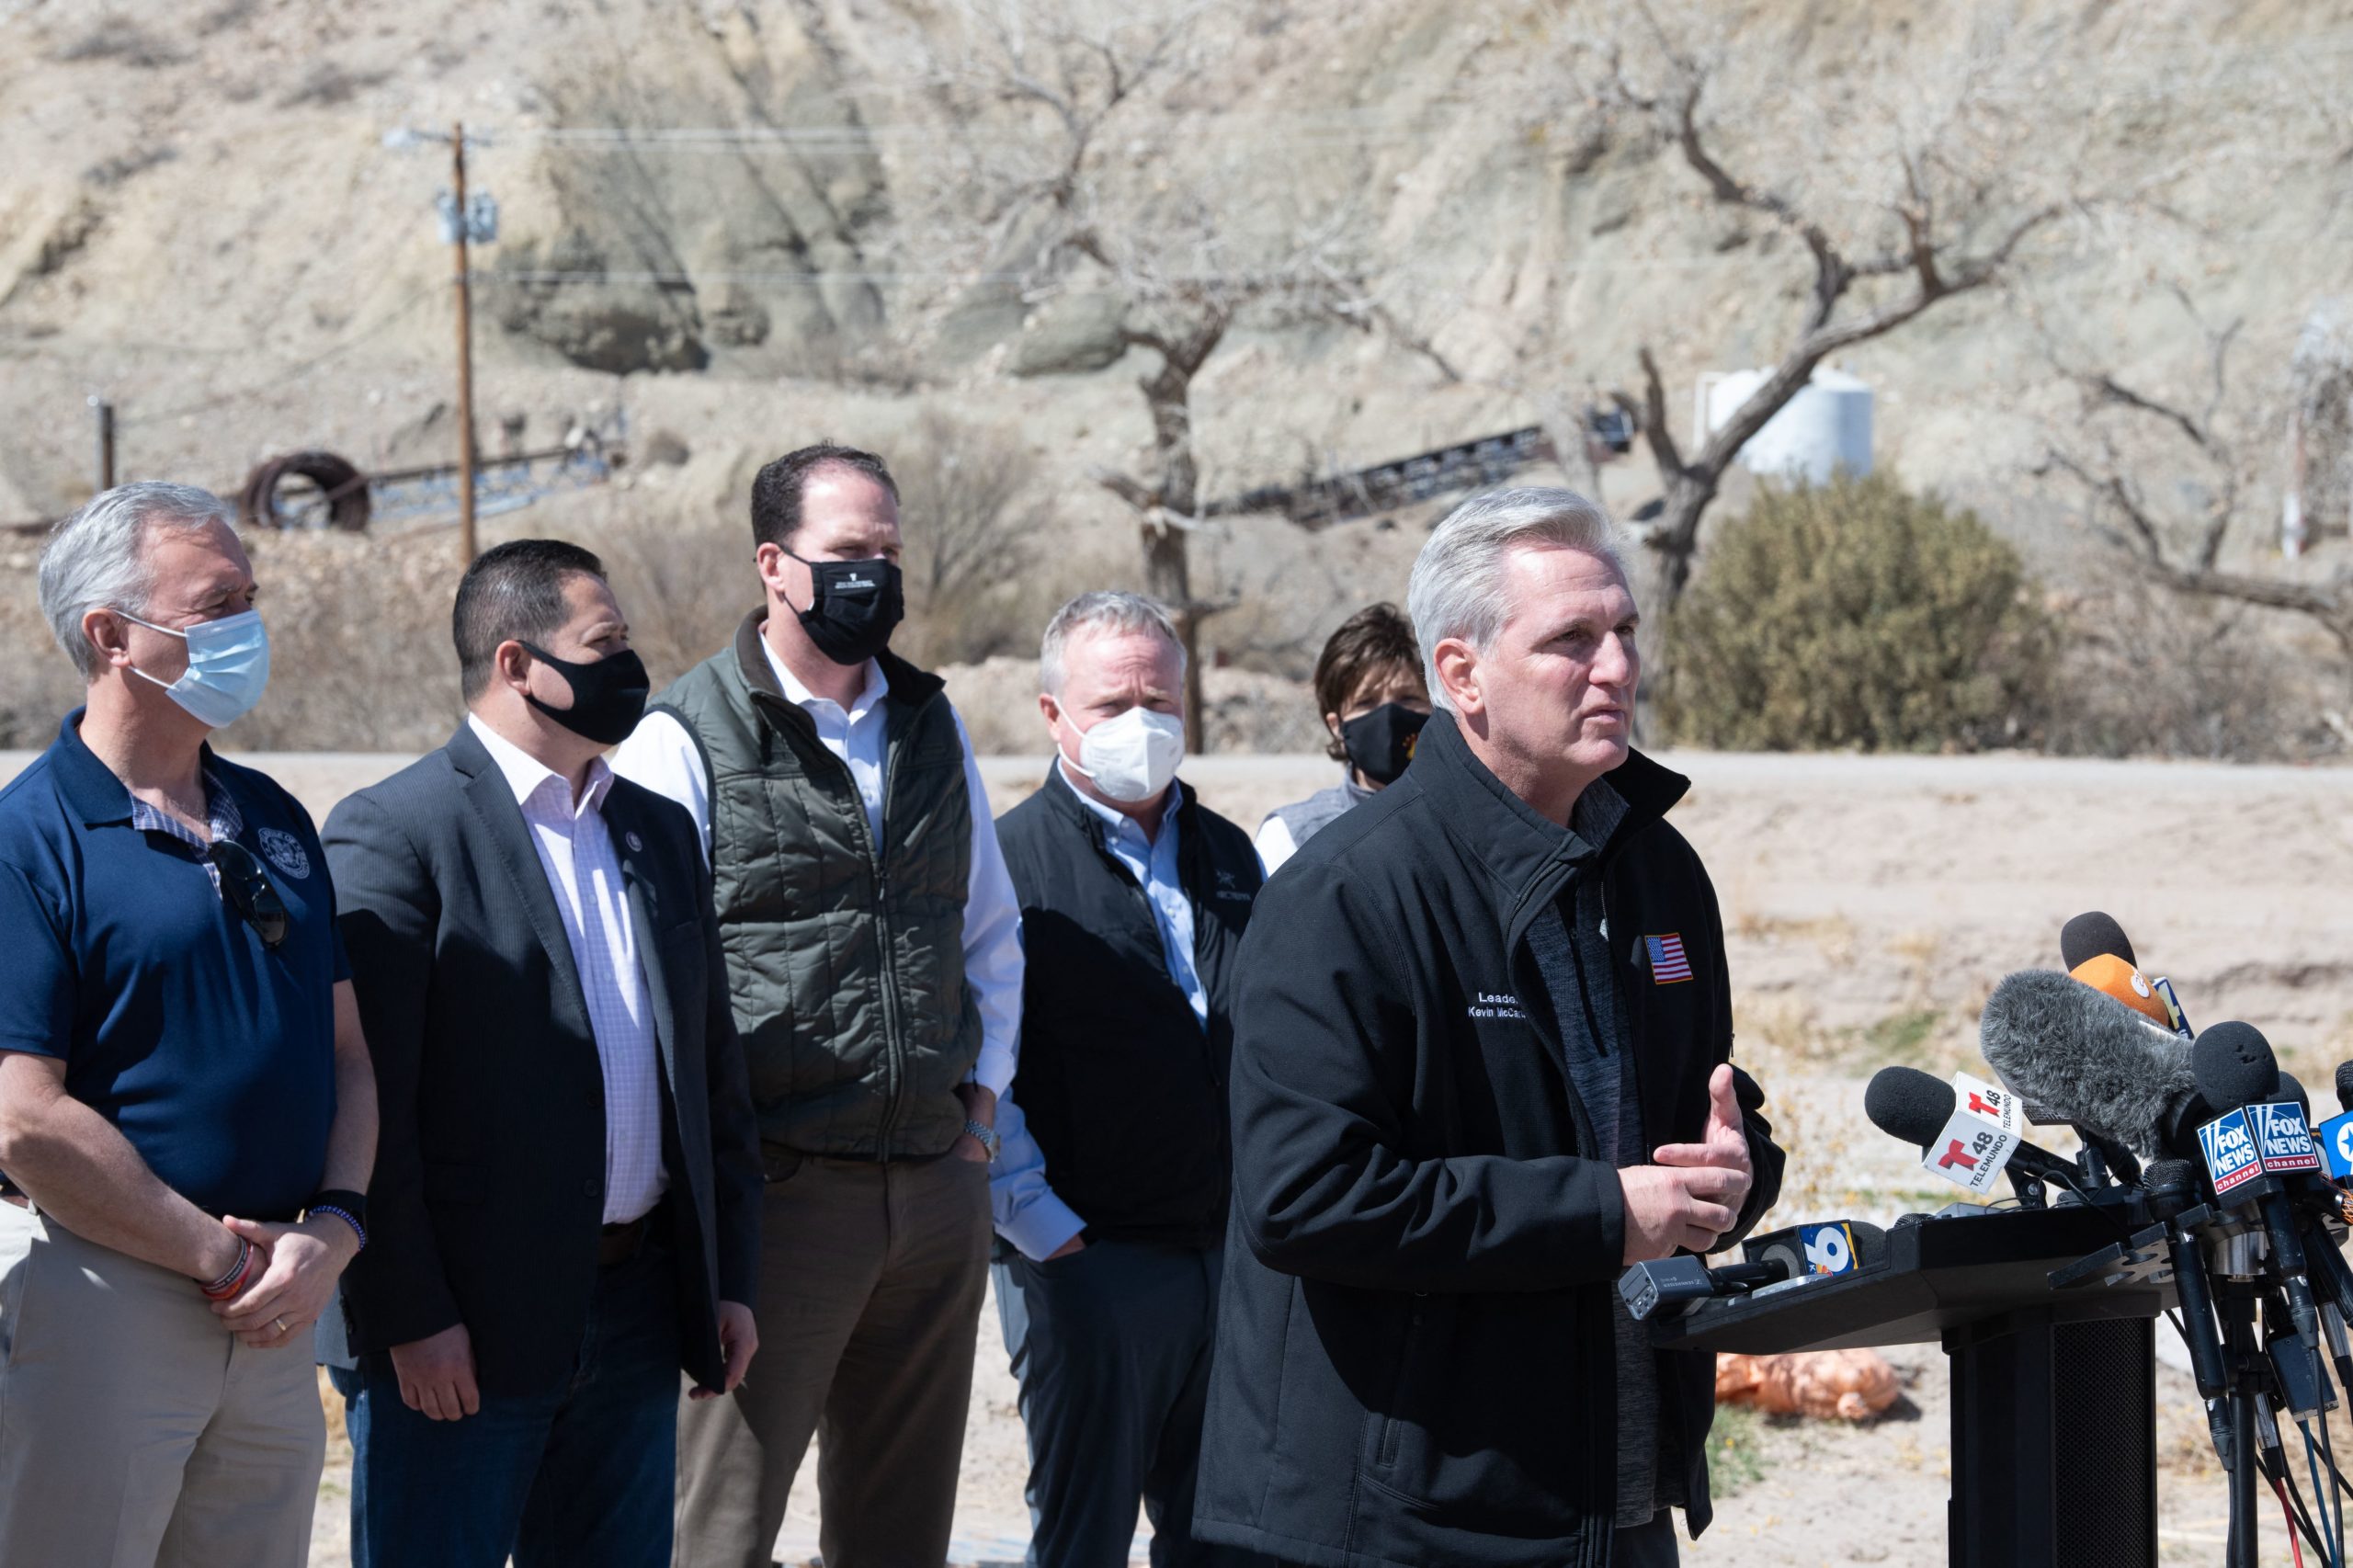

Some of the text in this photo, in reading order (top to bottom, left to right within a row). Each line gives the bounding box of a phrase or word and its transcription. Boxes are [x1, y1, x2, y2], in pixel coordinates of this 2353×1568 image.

[1478, 992, 1518, 1005] Leade
[1468, 1006, 1526, 1018] Kevin McCar
[1986, 1090, 2001, 1107] 48
[2003, 1094, 2012, 1130] TELEMUNDO
[2269, 1118, 2306, 1137] FOX
[1972, 1131, 1994, 1155] 48
[2217, 1124, 2249, 1154] FOX
[2265, 1136, 2312, 1155] NEWS
[1970, 1134, 2007, 1187] TELEMUNDO
[2214, 1143, 2255, 1176] NEWS
[2267, 1156, 2316, 1168] channel
[2217, 1165, 2259, 1190] channel
